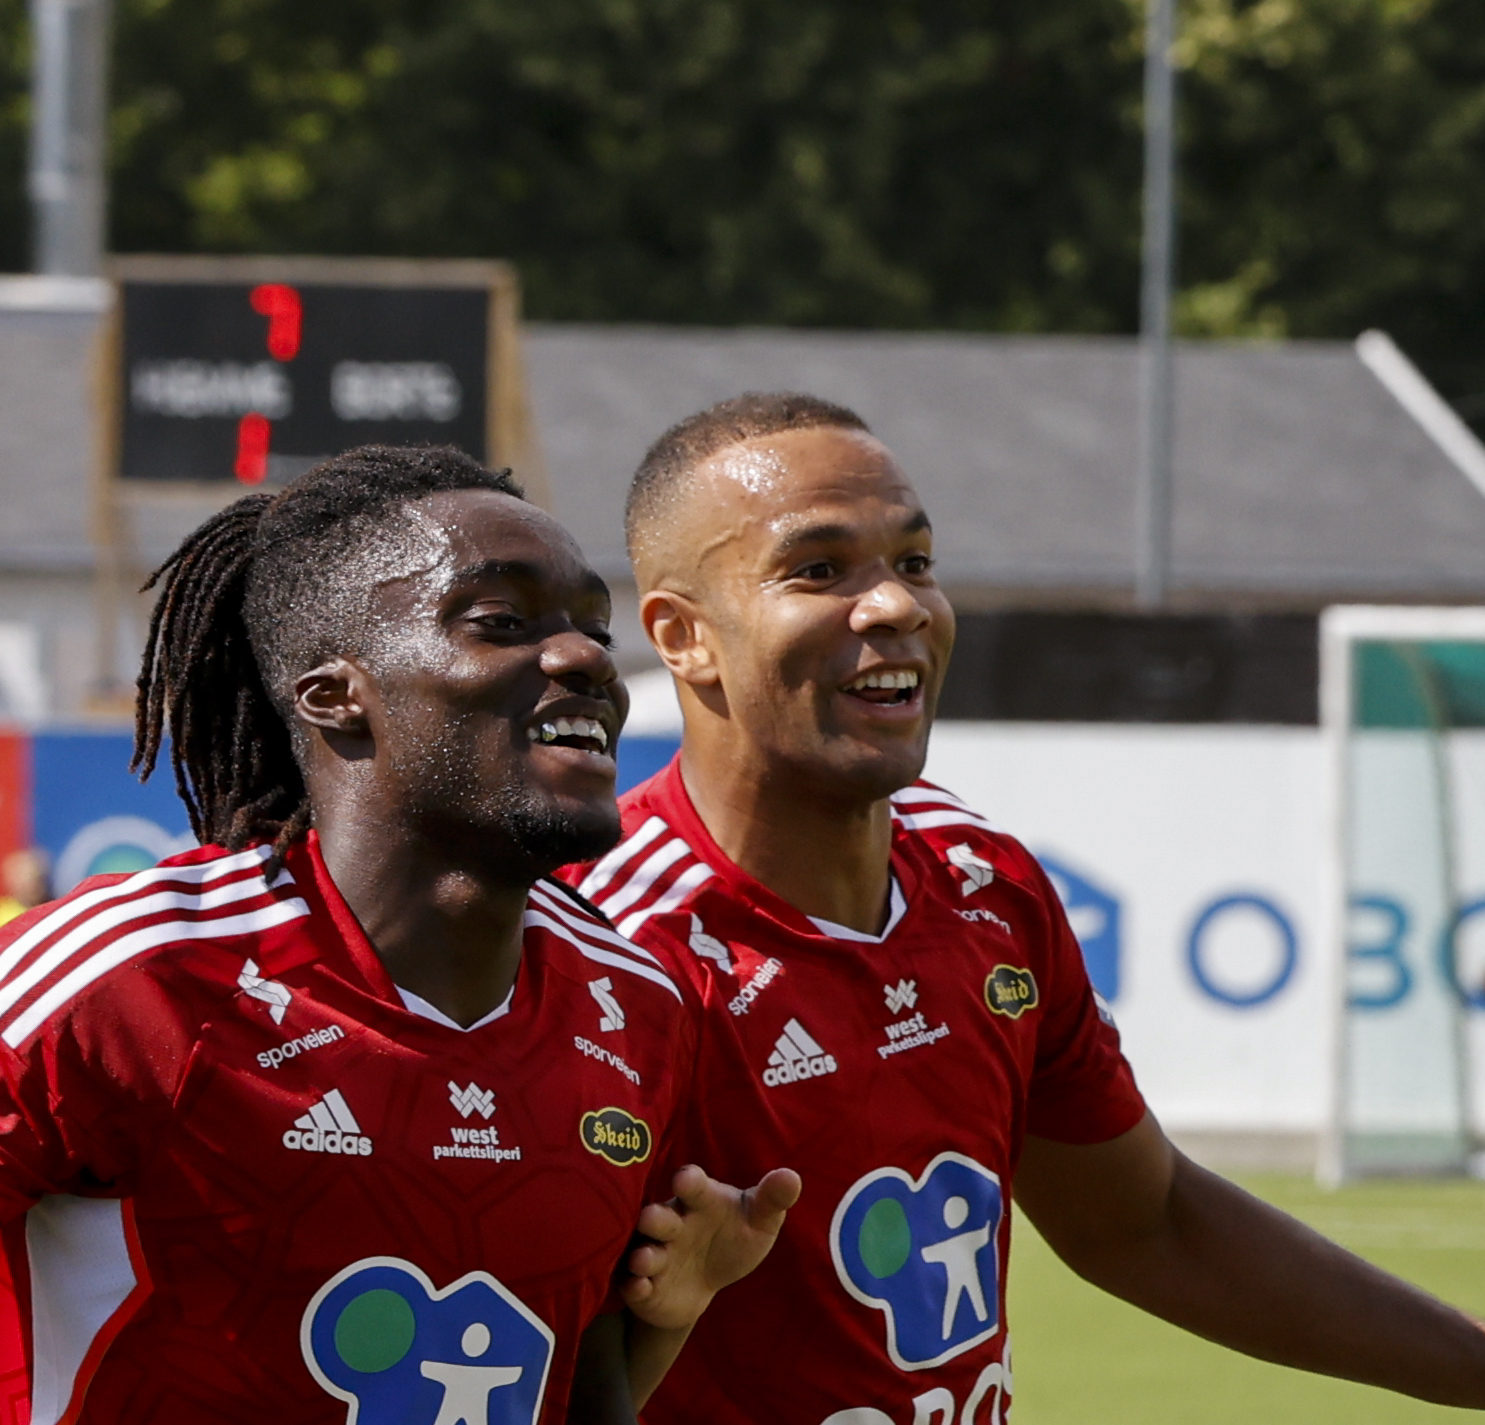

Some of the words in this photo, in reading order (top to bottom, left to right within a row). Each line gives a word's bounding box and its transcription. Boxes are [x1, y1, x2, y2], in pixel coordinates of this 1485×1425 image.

[728, 957, 783, 1016] sporveien
[884, 1011, 928, 1040] west
[256, 1023, 345, 1069] sporveien
[574, 1036, 641, 1085] sporveen
[762, 1053, 838, 1088] adidas
[282, 1128, 373, 1157] adidas
[451, 1126, 499, 1145] west
[593, 1121, 641, 1151] Skeid
[433, 1144, 521, 1164] parkettsliperi
